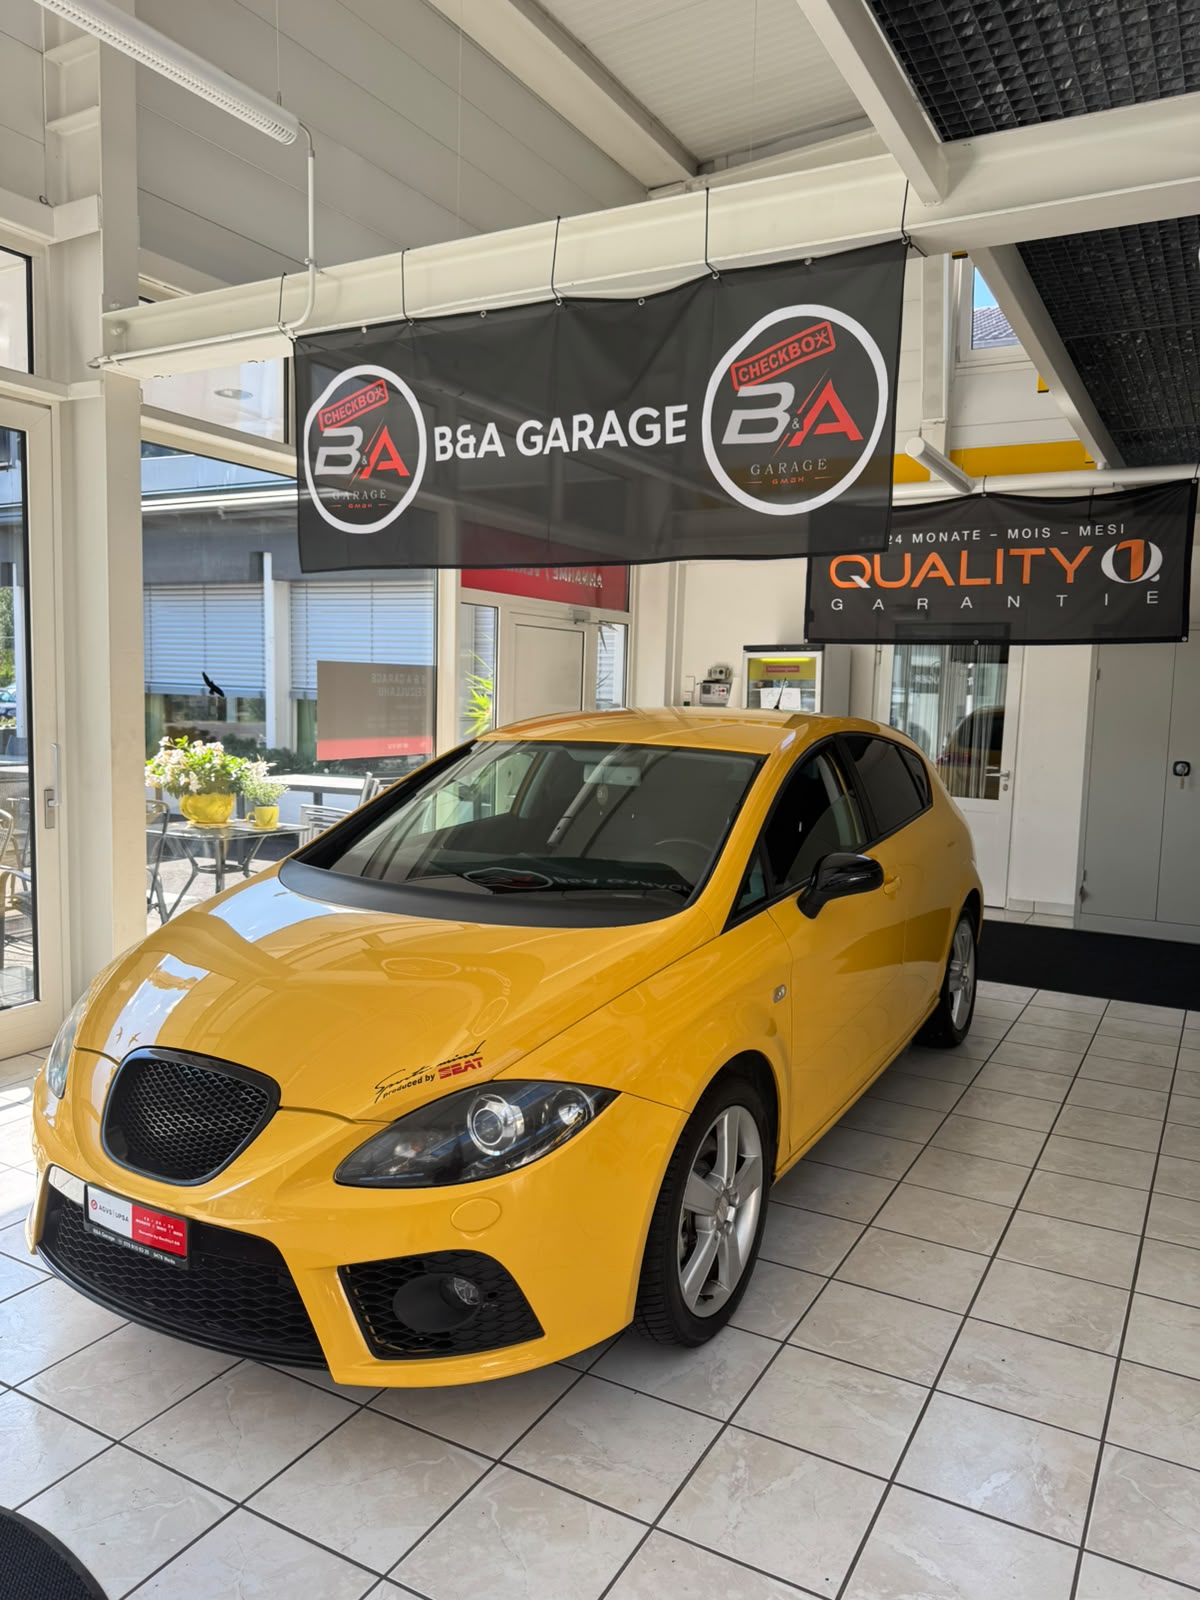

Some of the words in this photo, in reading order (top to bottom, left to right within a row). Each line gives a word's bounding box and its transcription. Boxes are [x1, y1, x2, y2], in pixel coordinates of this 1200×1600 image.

[738, 328, 830, 383] CHECKBOX
[323, 386, 385, 425] CHECKBOX
[434, 422, 506, 462] B&A
[515, 404, 688, 457] GARAGE
[750, 458, 828, 476] GARAGE
[332, 489, 387, 500] GARAGE
[912, 529, 982, 544] MONATE
[1007, 527, 1051, 540] MOIS
[1078, 523, 1125, 537] MESI
[829, 545, 1093, 589] QUALITY
[830, 590, 1159, 611] GARANTIE
[382, 1076, 423, 1099] produced
[425, 1073, 436, 1083] by
[437, 1057, 484, 1080] SEAT
